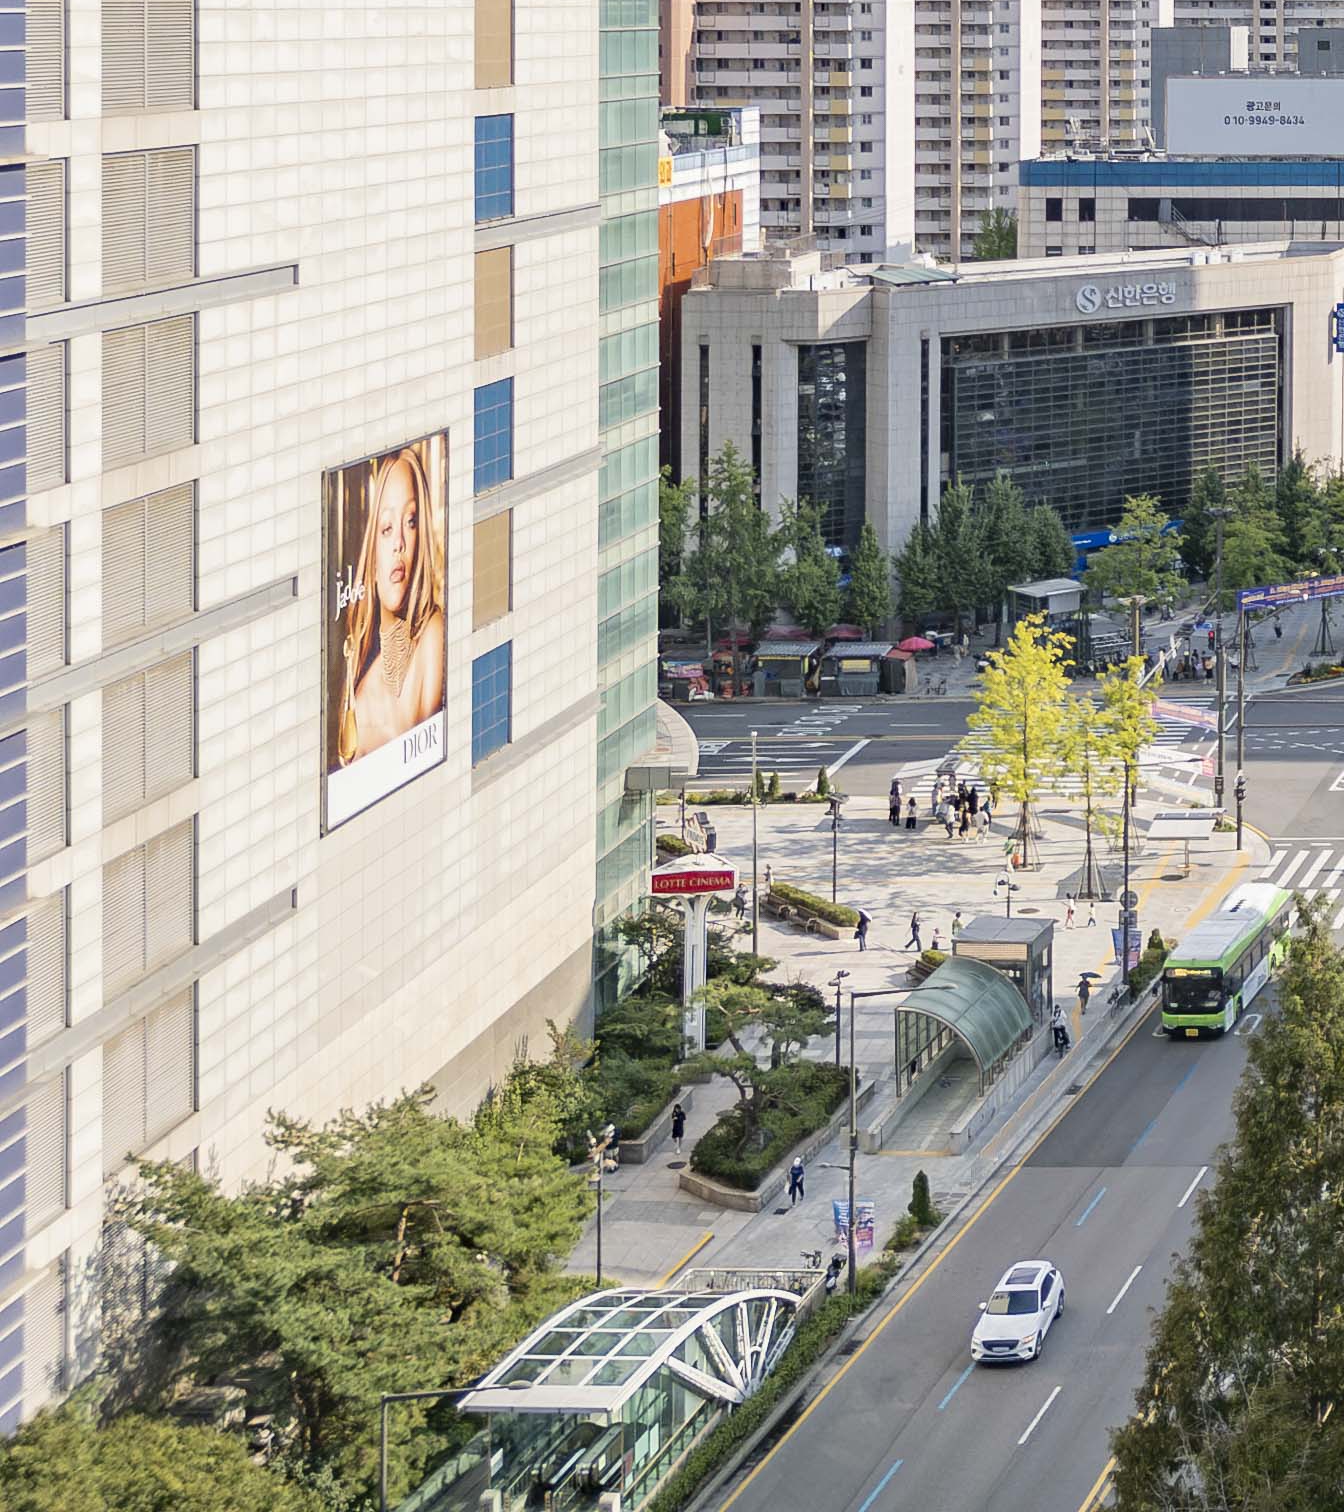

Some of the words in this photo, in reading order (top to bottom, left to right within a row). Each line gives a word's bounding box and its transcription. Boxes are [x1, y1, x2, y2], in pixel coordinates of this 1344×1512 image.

[1246, 101, 1281, 112] 광고문의
[1104, 282, 1176, 308] 신한은행
[403, 723, 438, 766] DIOR
[655, 878, 687, 889] LOTTE
[689, 876, 731, 886] CINEMA
